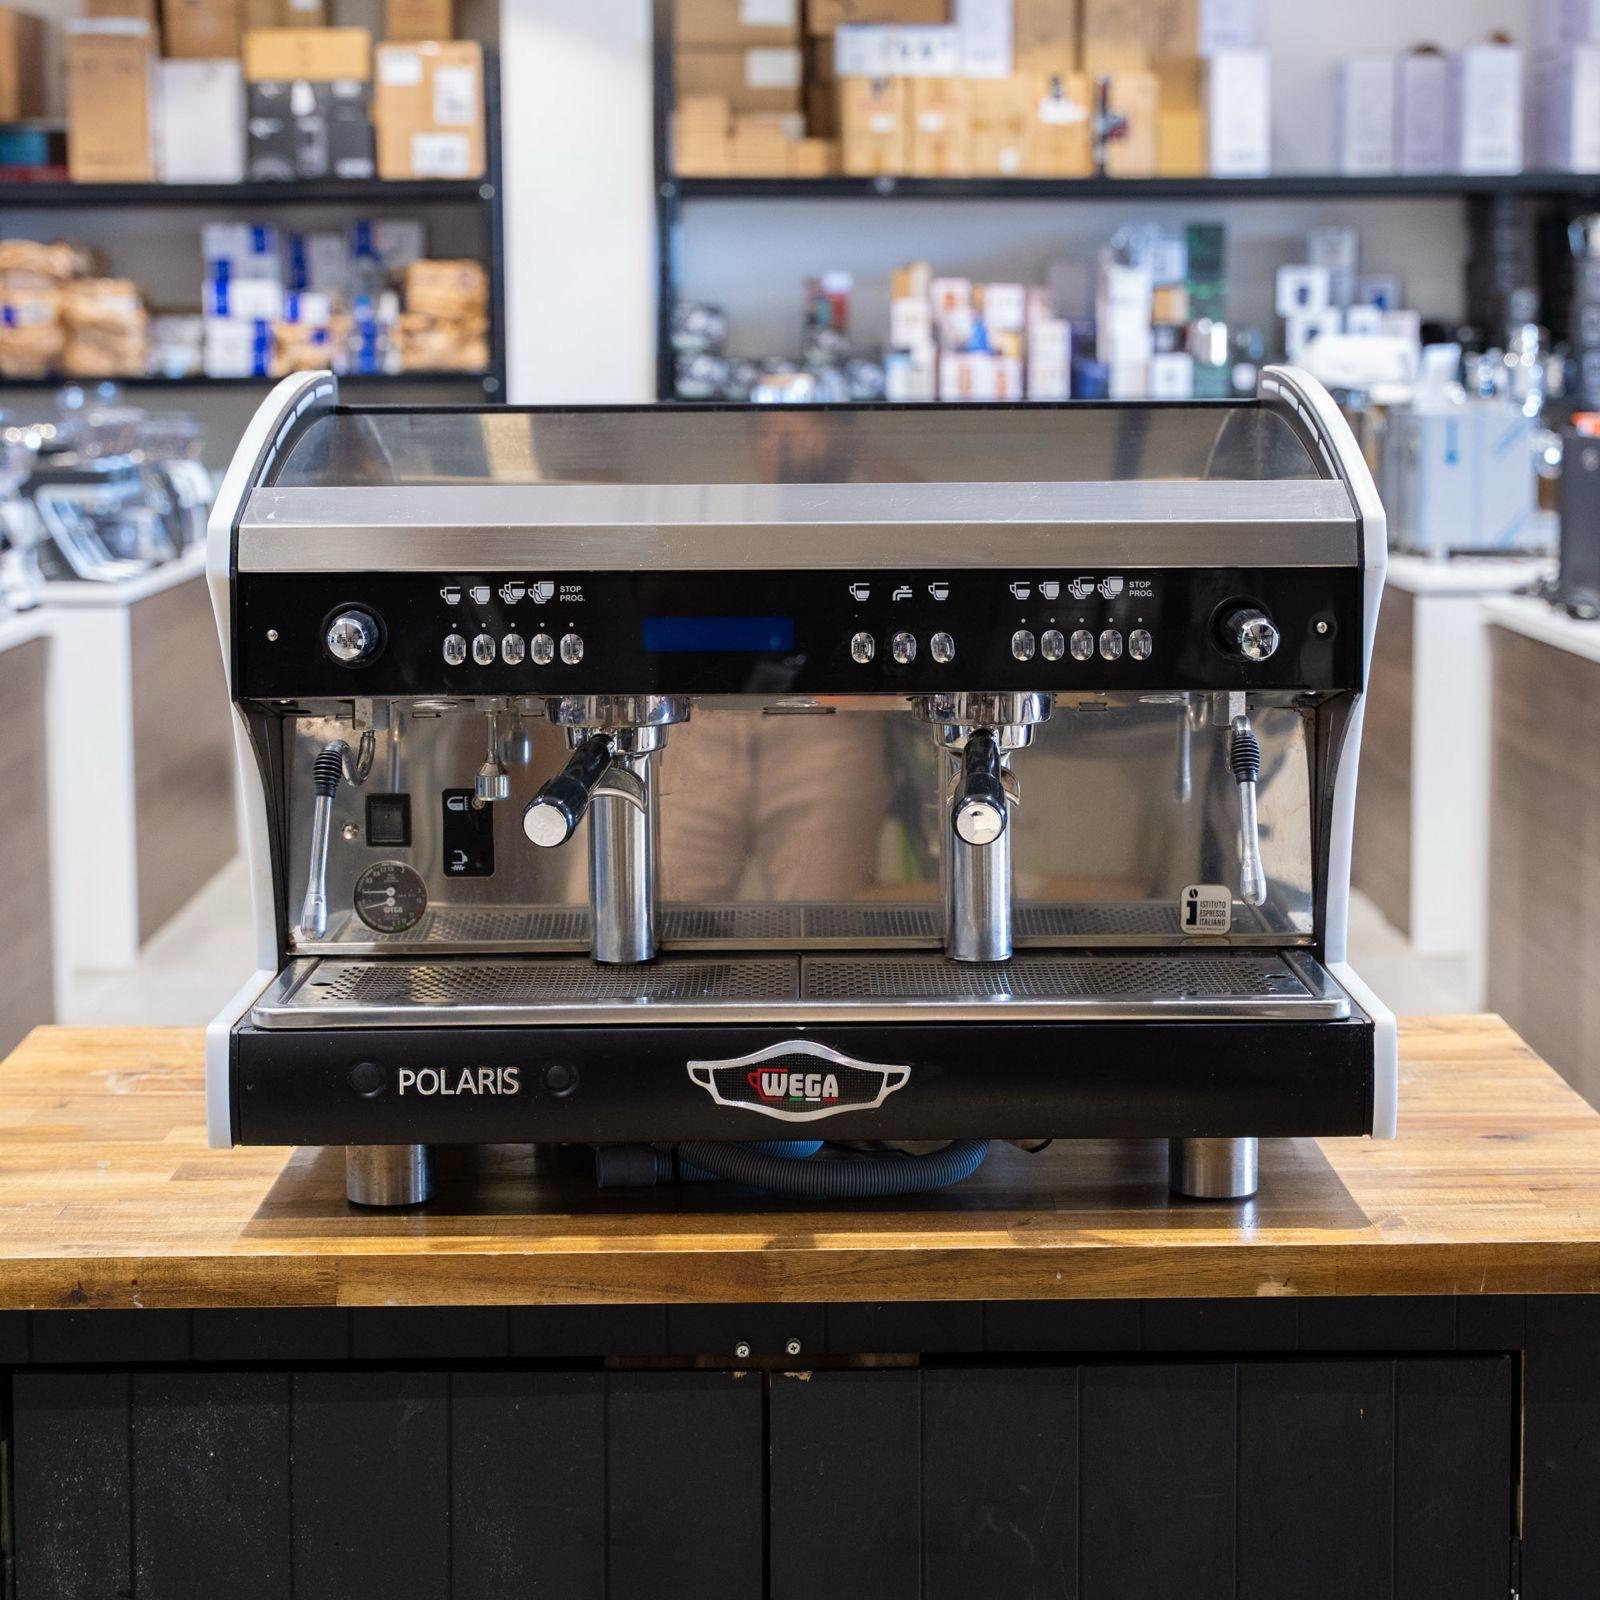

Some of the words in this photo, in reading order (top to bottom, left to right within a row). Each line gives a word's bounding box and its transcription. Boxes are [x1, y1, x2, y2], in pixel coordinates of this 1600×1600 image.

[559, 585, 582, 593] STOP
[559, 594, 586, 602] PROG.
[398, 1066, 521, 1096] POLARIS
[761, 1072, 839, 1098] WEGA
